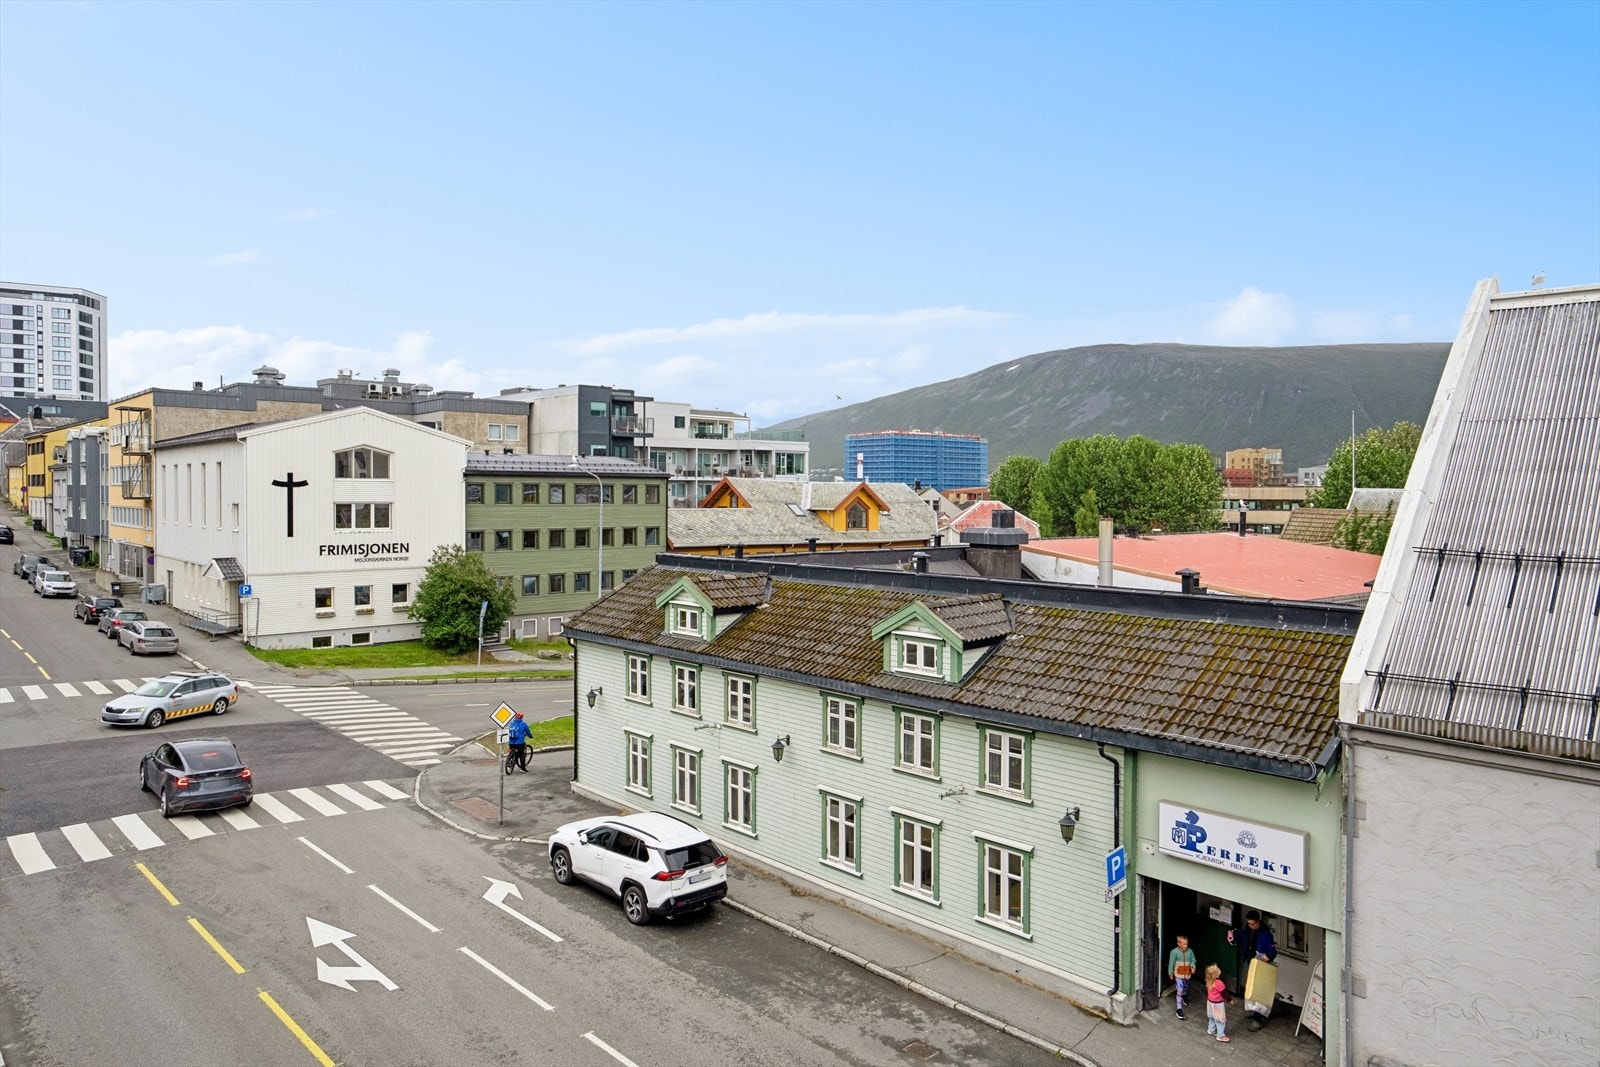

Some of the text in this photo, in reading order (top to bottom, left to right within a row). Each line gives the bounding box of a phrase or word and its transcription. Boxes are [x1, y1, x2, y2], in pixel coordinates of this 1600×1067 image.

[319, 543, 410, 557] FRIMISJONEN
[243, 586, 250, 594] P
[1175, 820, 1291, 876] PERFEKT
[1111, 855, 1121, 881] P
[1195, 854, 1261, 875] KJEMISK RENSERI
